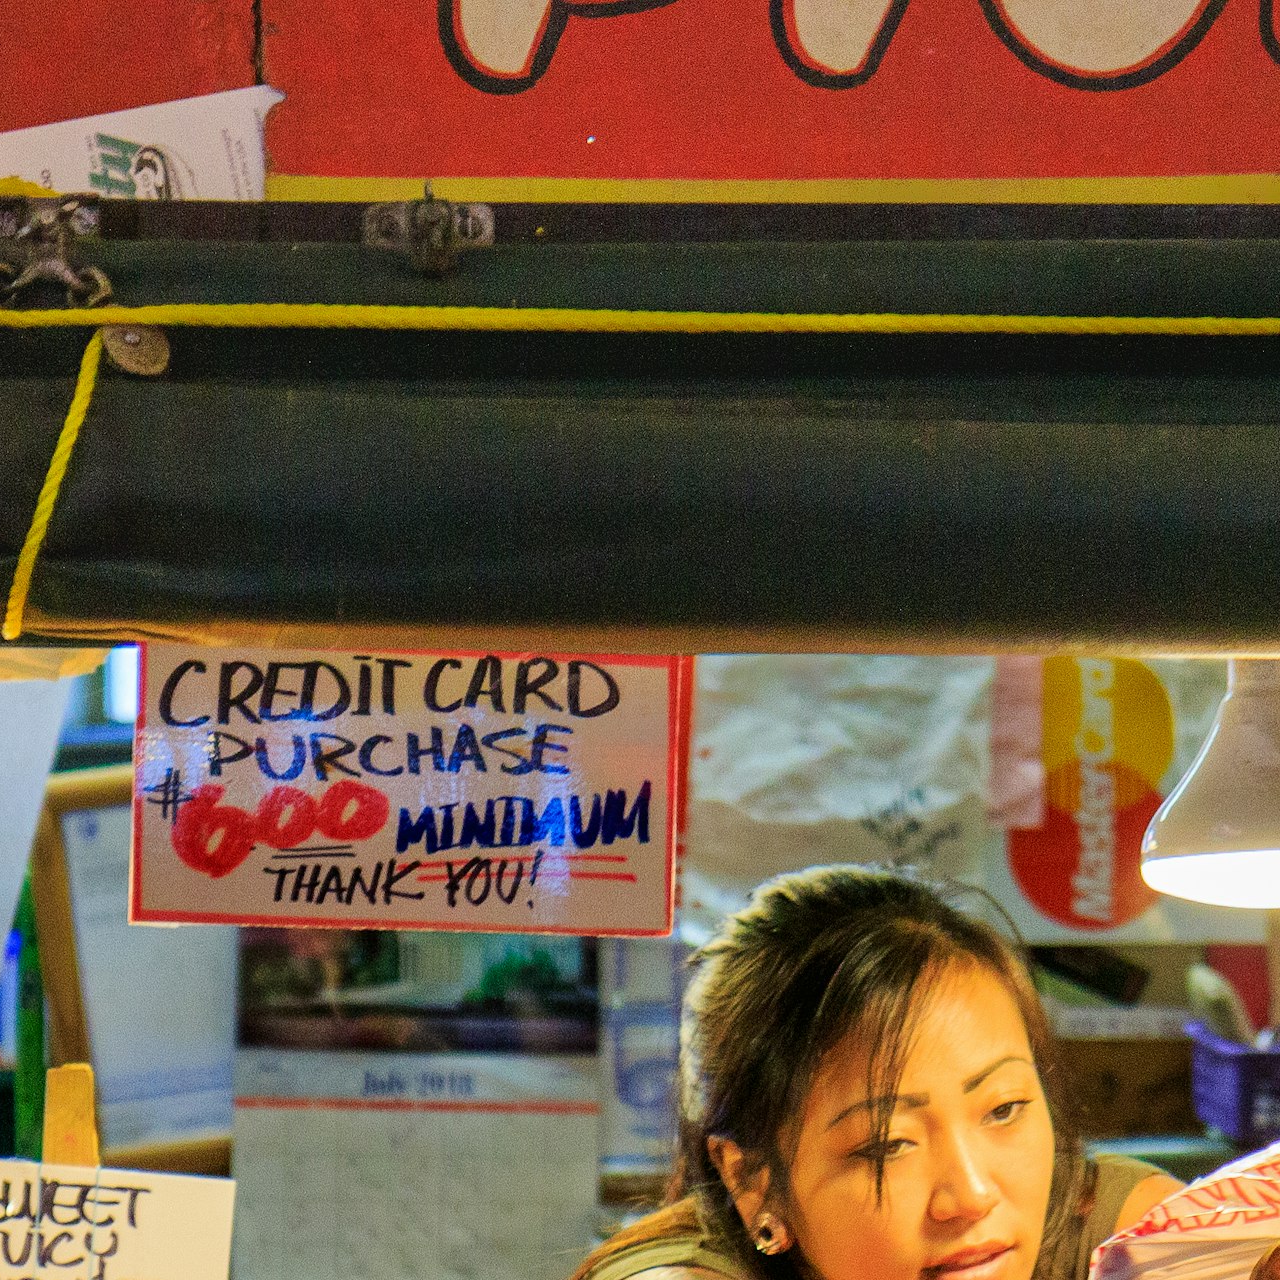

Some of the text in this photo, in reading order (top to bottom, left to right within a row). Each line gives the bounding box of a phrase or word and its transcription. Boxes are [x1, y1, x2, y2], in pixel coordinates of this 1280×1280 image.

[158, 656, 620, 728] CREDIT CARD
[208, 724, 574, 781] PURCHASE
[396, 779, 652, 854] MINIMUM
[265, 853, 542, 909] THANK YOU!
